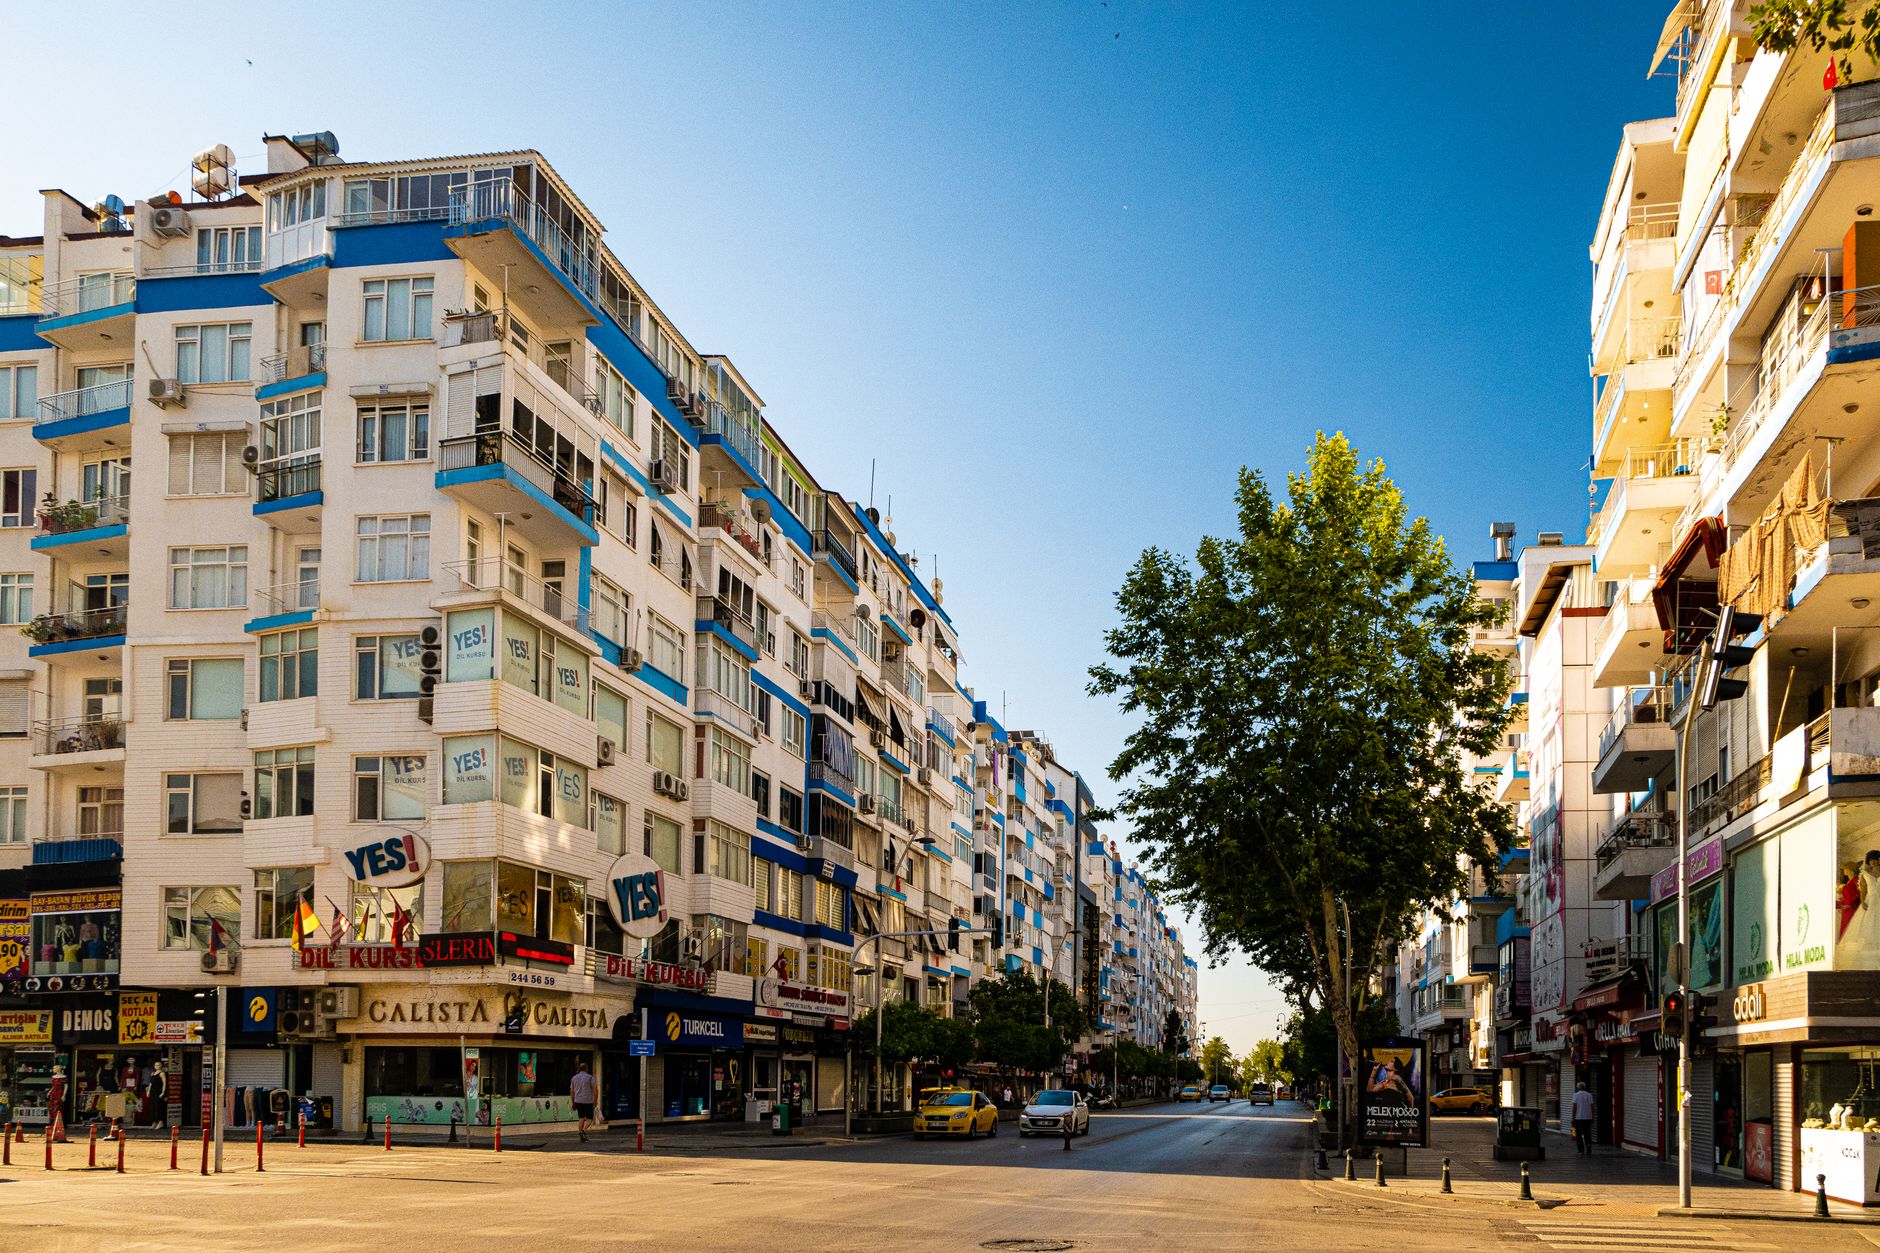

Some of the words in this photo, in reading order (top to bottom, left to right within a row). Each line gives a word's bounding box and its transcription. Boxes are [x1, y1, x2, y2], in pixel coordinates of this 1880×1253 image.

[453, 624, 487, 651] YES!
[506, 637, 530, 660] YES!
[557, 667, 580, 688] YES!
[453, 748, 487, 774] YES!
[504, 756, 529, 777] YES!
[556, 767, 581, 799] YES
[344, 834, 420, 881] YES!
[613, 870, 668, 923] YES!
[1804, 945, 1826, 964] MODA
[511, 972, 528, 983] 244
[531, 974, 542, 984] 56
[544, 975, 555, 985] 59
[644, 962, 706, 989] KURSU
[121, 996, 140, 1006] SEÇ
[142, 995, 156, 1004] AL
[122, 1006, 155, 1017] KOTLAR
[369, 999, 489, 1023] CALISTA
[62, 1008, 112, 1031] DEMOS
[534, 1002, 609, 1030] CALISTA
[683, 1019, 724, 1037] TURKCELL
[1366, 1105, 1392, 1117] MELEK
[1366, 1119, 1376, 1127] 22
